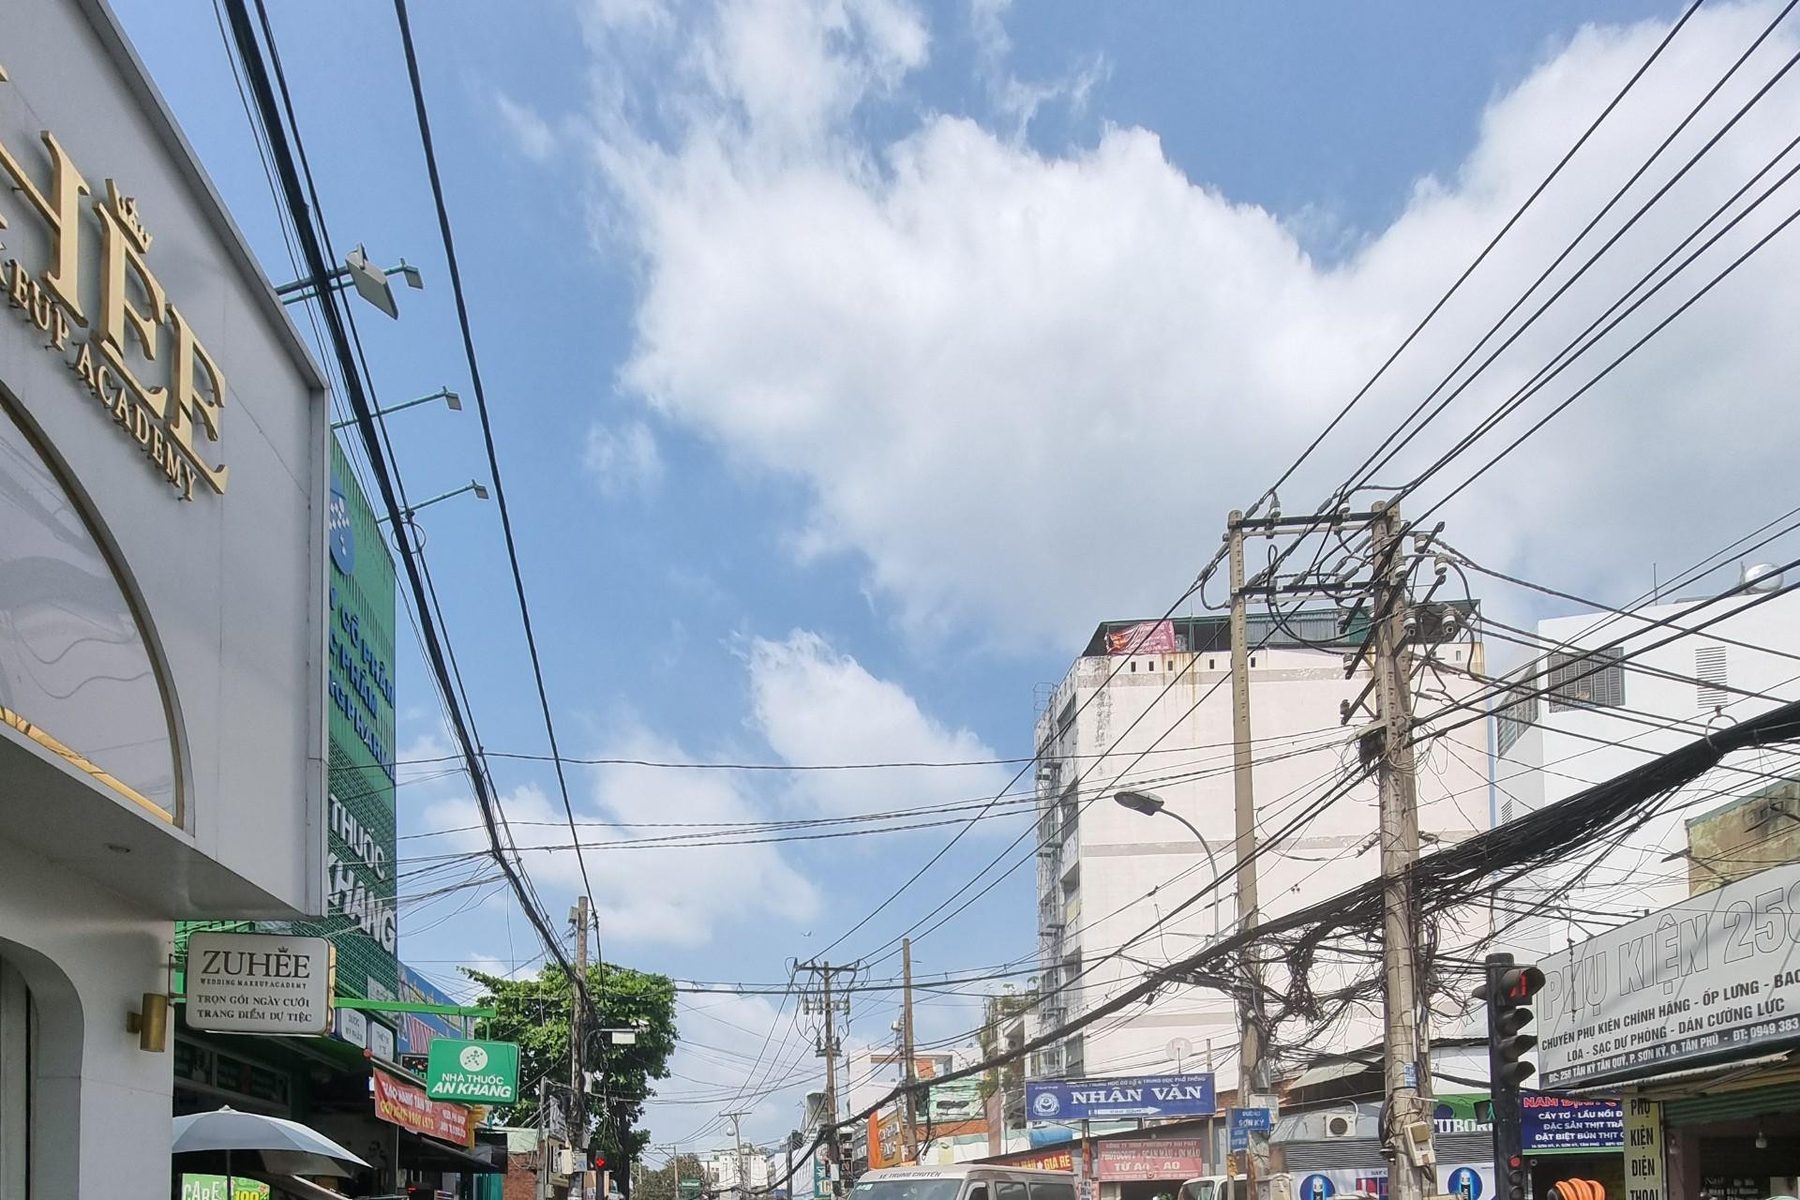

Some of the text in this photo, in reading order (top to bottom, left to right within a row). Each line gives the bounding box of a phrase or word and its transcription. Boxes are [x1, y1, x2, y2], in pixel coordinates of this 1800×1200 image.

[73, 341, 197, 502] ACADEMY
[330, 793, 386, 881] THUỐC
[1543, 950, 1606, 1021] PHỤ
[1618, 913, 1709, 996] KIỆN
[200, 978, 235, 986] WEDDING
[270, 981, 307, 989] ACADEMY
[197, 993, 310, 1008] TRỌN GÓI NGÀY CƯỚI
[197, 1008, 312, 1023] TRANG ĐIỂM DỰ TIỆC
[1541, 1031, 1575, 1051] CHUYÊN
[1577, 1026, 1595, 1039] PHỤ
[1598, 1018, 1621, 1034] KIỆN
[1623, 1008, 1656, 1028] CHÍNH
[1703, 988, 1719, 1006] ỐP
[1723, 980, 1760, 1001] LƯNG
[1567, 998, 1785, 1062] LOA SẠC DỰ PHÒNG DÁN CƯỜNG LỰC
[1638, 1049, 1654, 1061] SƠN
[1681, 1038, 1698, 1053] TÂN
[1750, 1023, 1776, 1038] 0949
[1778, 1018, 1799, 1032] 383
[441, 1072, 504, 1084] NHÀ THUỐC
[431, 1082, 512, 1098] AN KHANG
[1071, 1083, 1202, 1104] NHÂN VĂN
[1523, 1097, 1558, 1108] NAM
[1559, 1111, 1570, 1119] TƠ
[1564, 1119, 1583, 1129] SẢN
[1585, 1121, 1604, 1130] THỊT
[1555, 1131, 1575, 1142] BIỆT
[1598, 1131, 1618, 1140] THỊT
[1630, 1125, 1654, 1149] KIỆN
[1631, 1155, 1656, 1180] ĐIỆN
